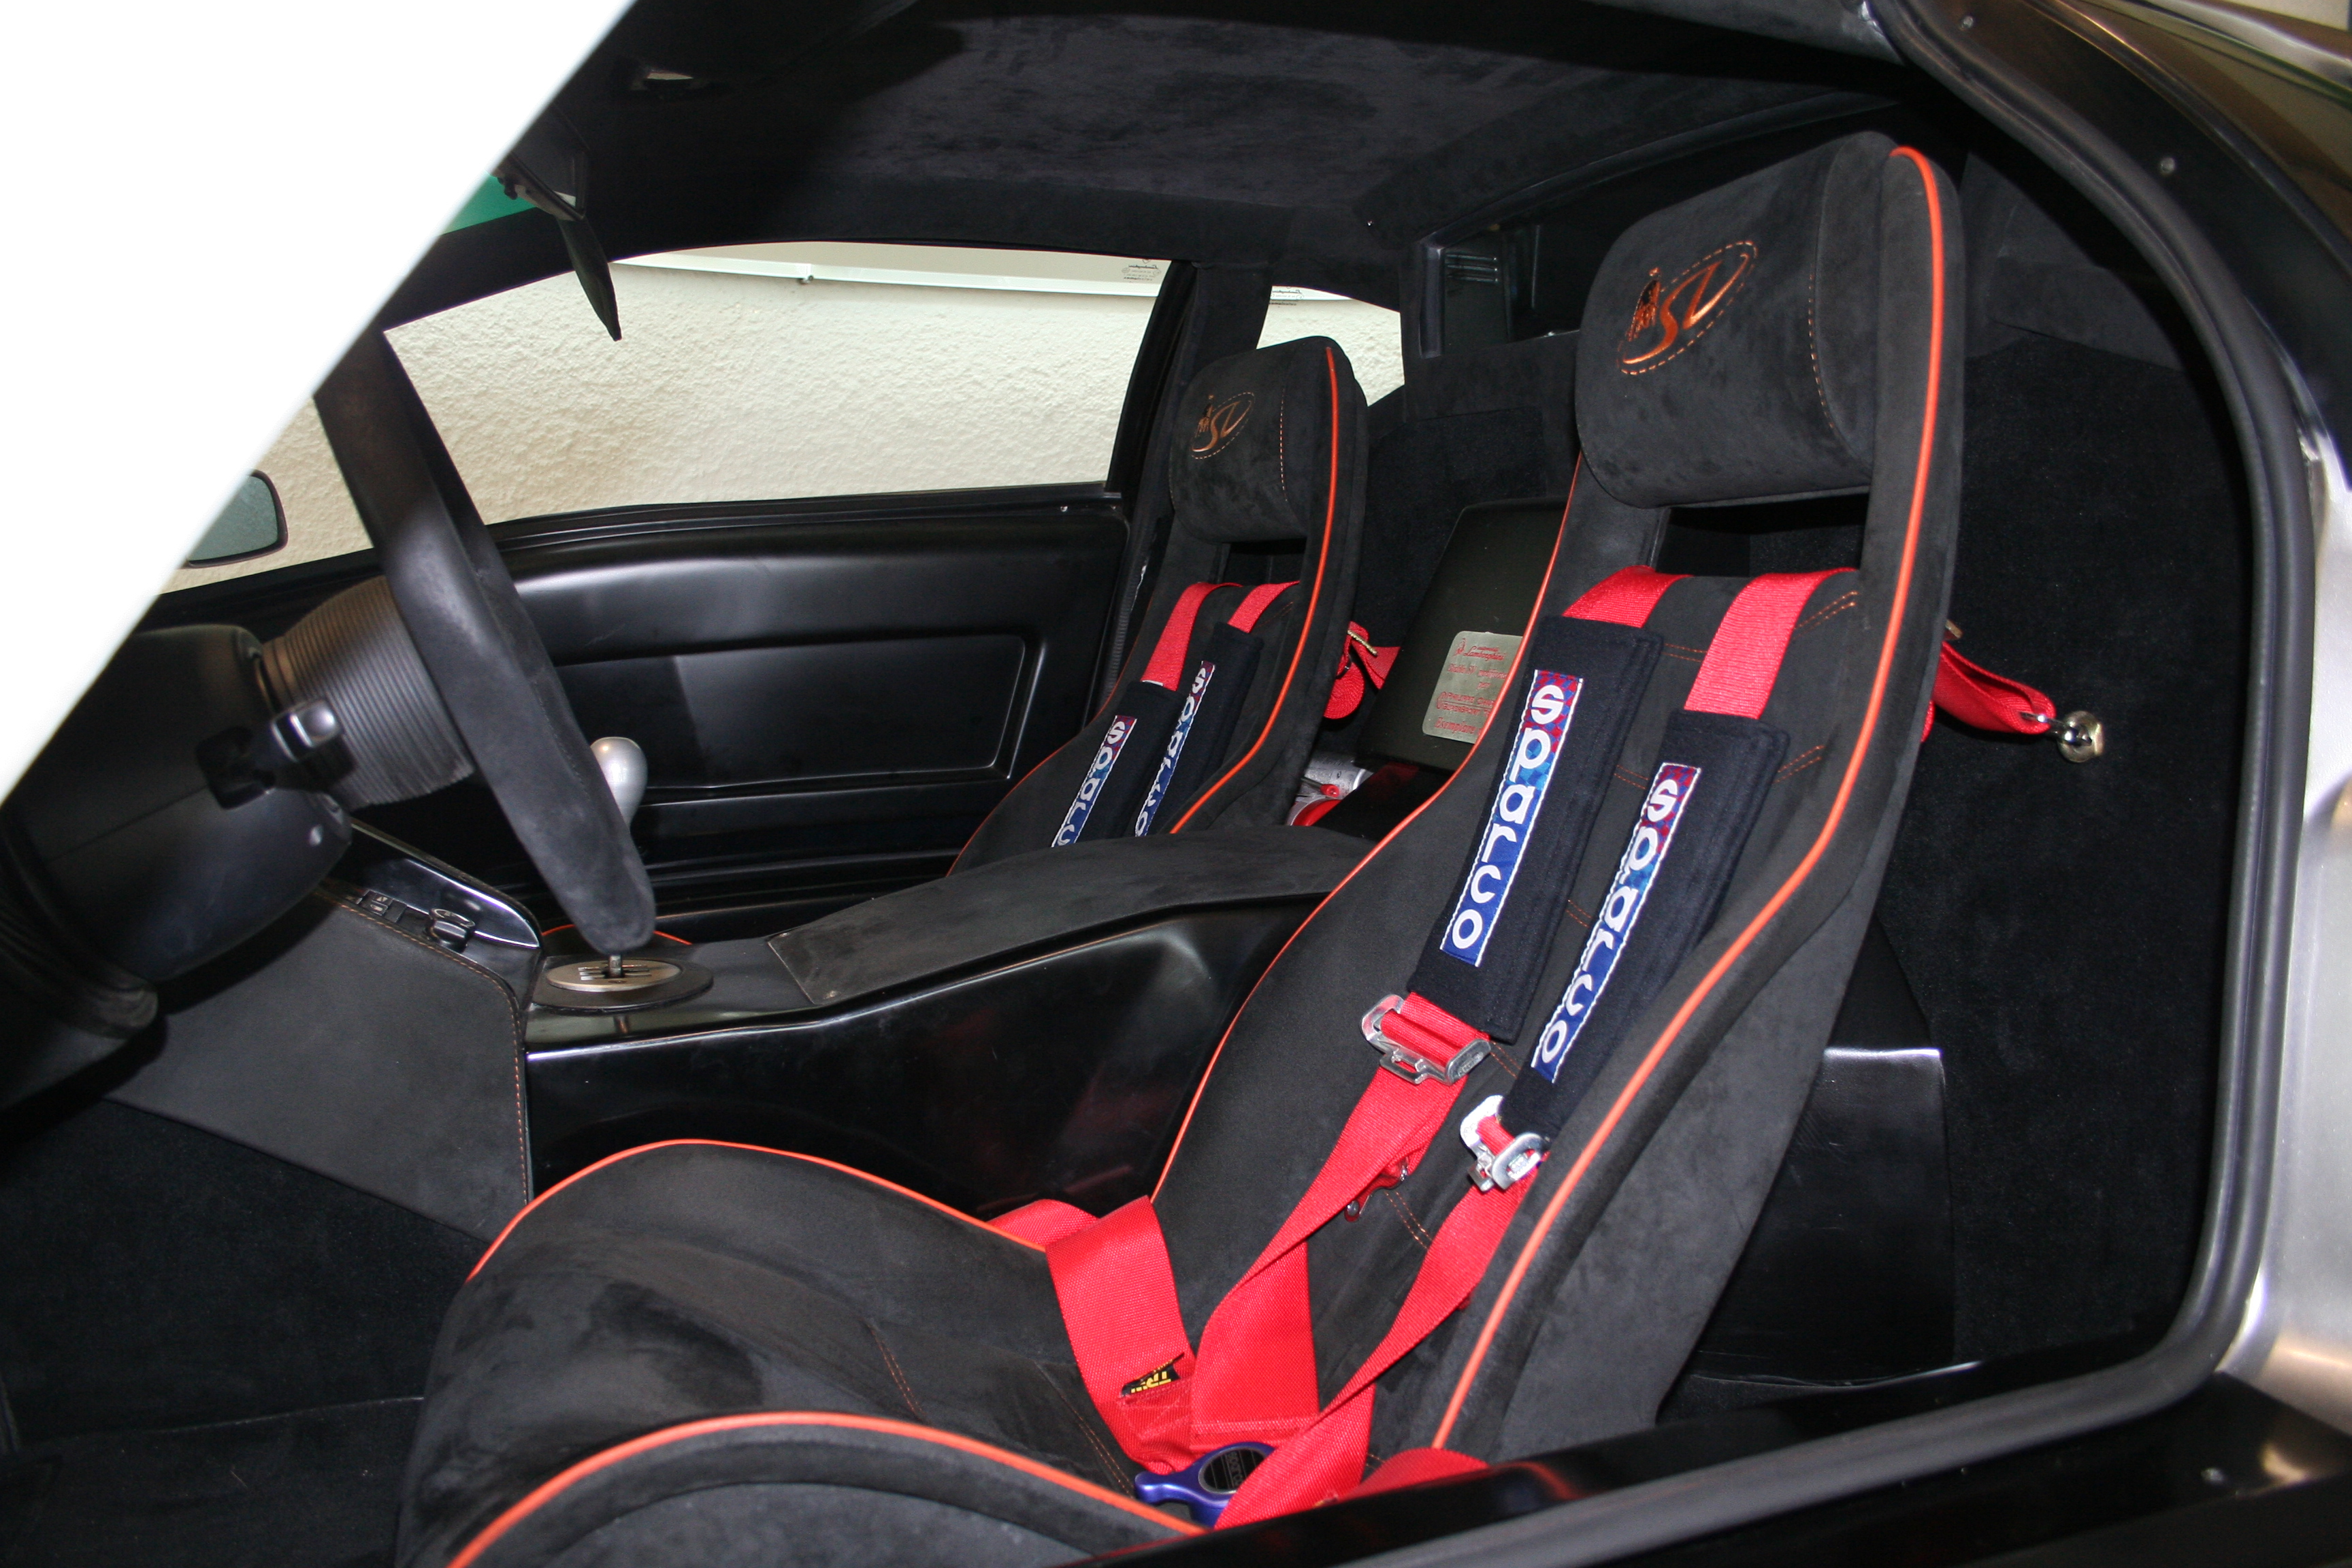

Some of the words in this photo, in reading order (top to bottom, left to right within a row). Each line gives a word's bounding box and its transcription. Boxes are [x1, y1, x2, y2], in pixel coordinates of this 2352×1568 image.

[1057, 721, 1126, 846] sparc
[1452, 683, 1564, 948] sparco
[1541, 779, 1677, 1062] sparco
